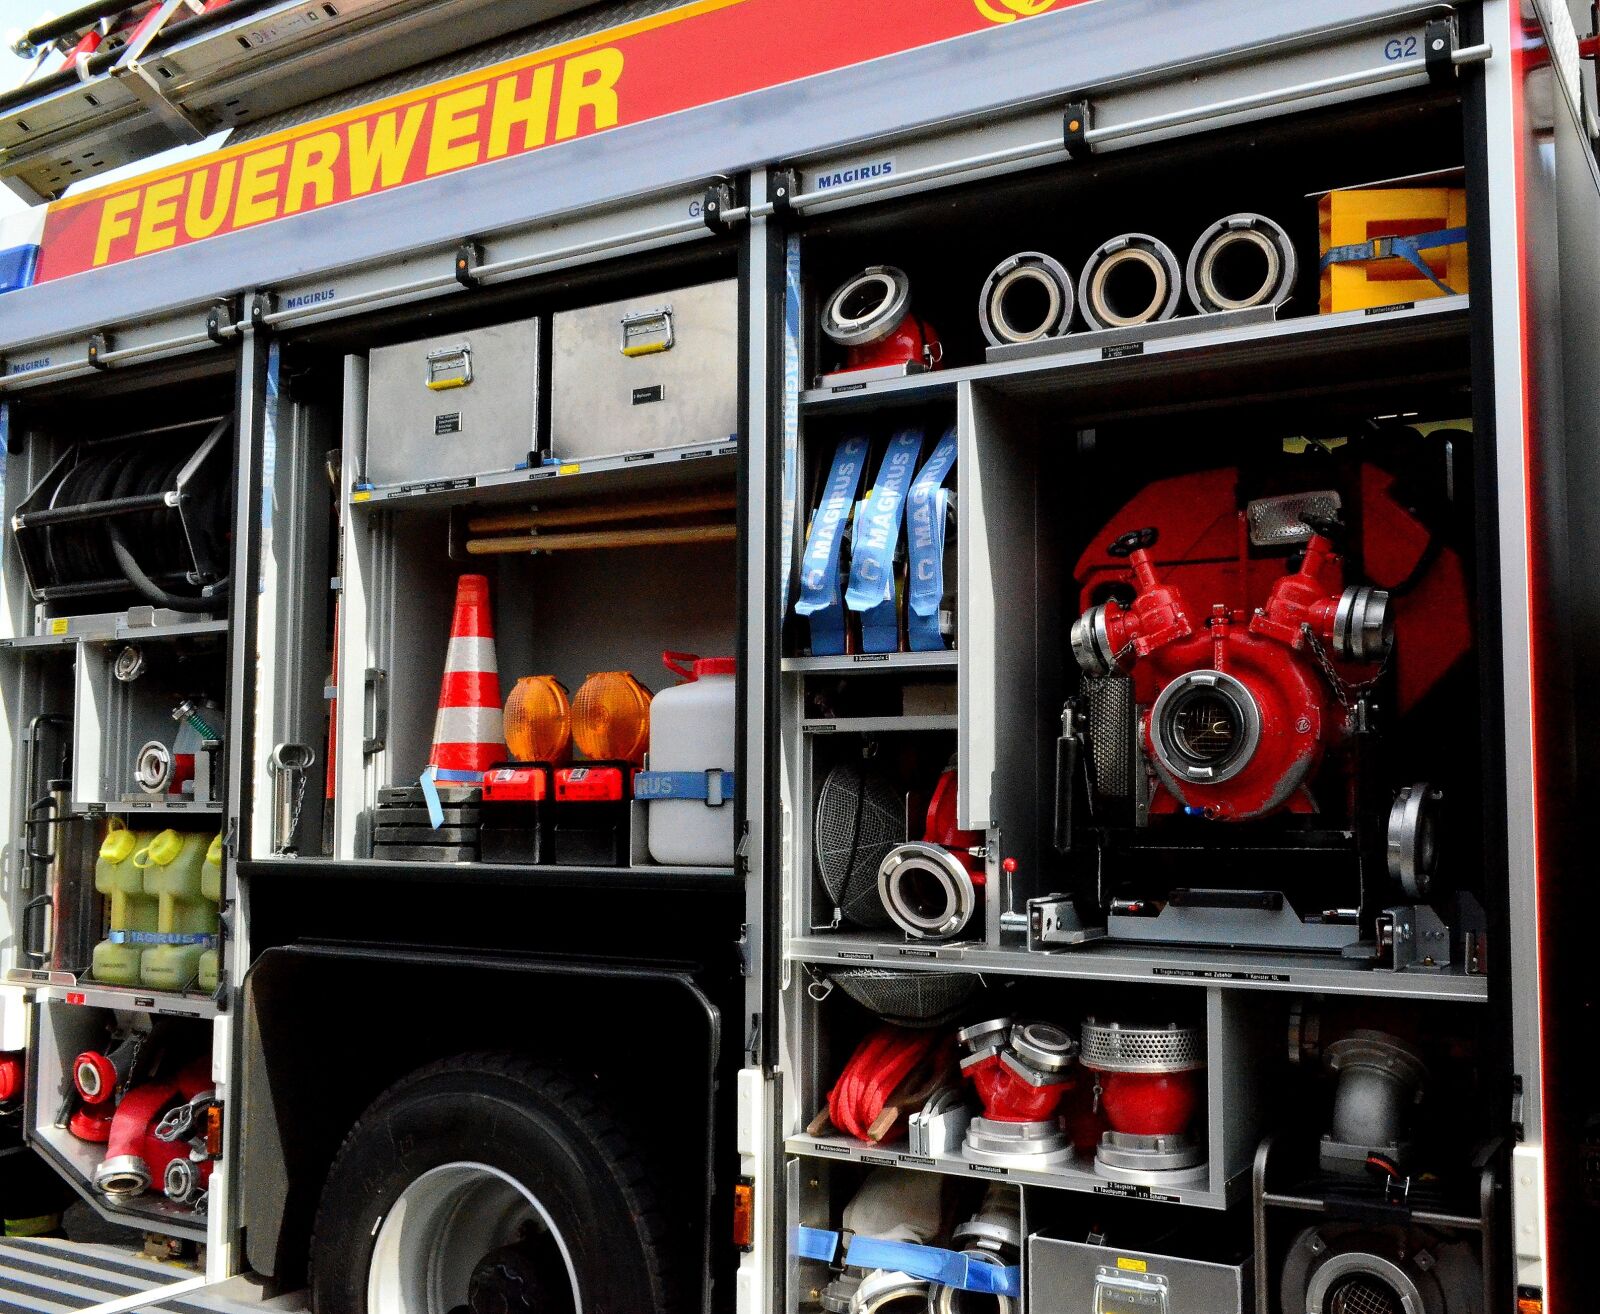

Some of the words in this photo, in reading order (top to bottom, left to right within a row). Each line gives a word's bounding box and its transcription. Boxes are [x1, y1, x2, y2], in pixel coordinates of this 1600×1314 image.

[1384, 36, 1417, 60] G2
[93, 46, 625, 267] FEUERWEHR
[818, 161, 892, 189] MAGIRUS
[287, 289, 335, 309] MAGIRUS
[13, 357, 50, 374] MAGIRUS
[812, 461, 855, 560] MAGIRUS
[866, 451, 911, 550] MAGIRUS
[913, 443, 954, 549] MAGIRUS
